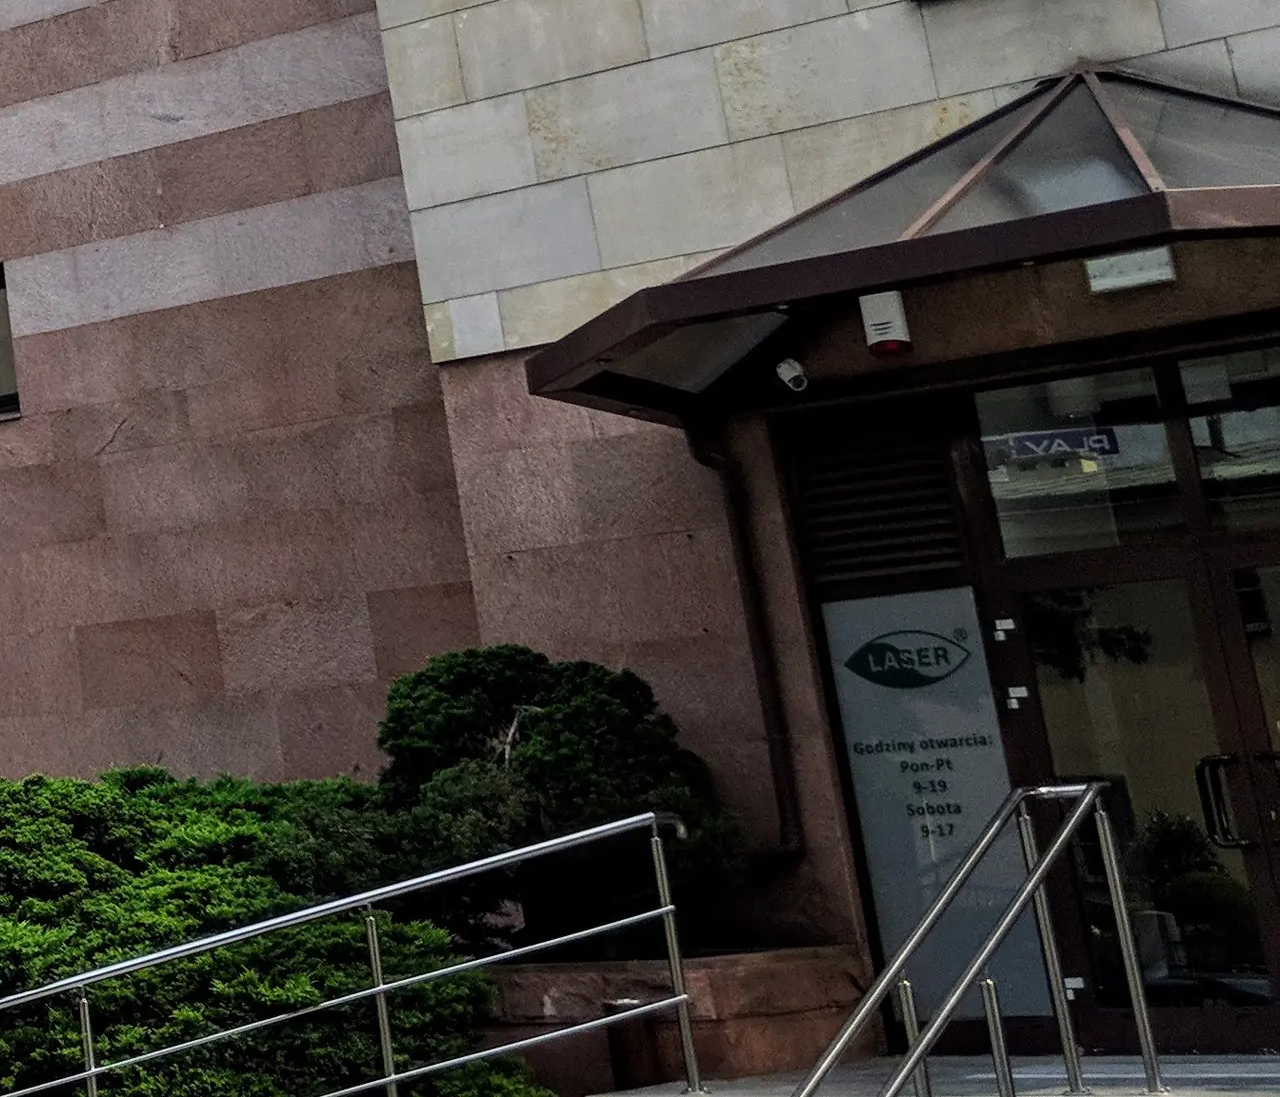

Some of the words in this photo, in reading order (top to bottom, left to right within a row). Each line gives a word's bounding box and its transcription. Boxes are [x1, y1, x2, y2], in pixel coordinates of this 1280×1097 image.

[867, 646, 950, 673] LASER
[853, 740, 916, 755] Godziny
[919, 733, 993, 750] otwarcia:
[913, 779, 948, 794] 9-19
[906, 802, 962, 817] Sobota
